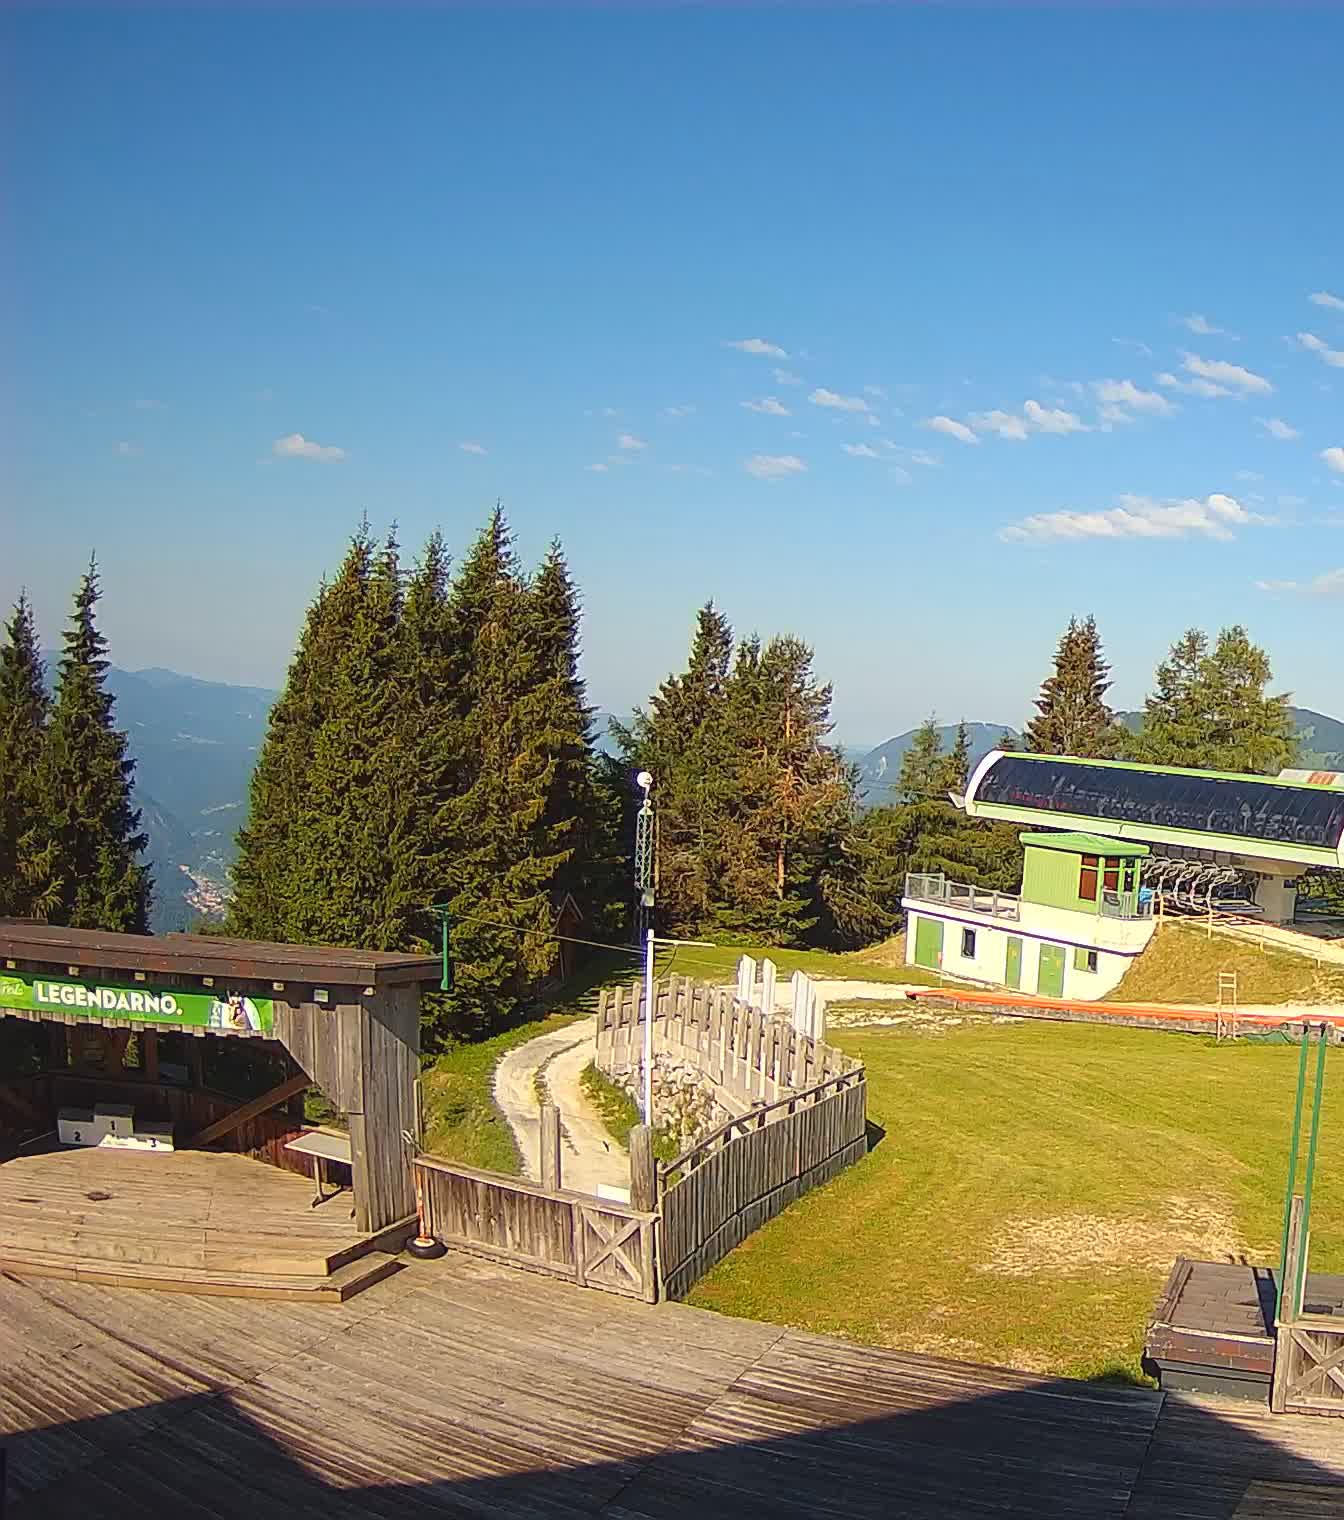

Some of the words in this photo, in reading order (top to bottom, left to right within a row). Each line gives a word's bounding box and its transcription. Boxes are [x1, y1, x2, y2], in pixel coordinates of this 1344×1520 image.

[37, 984, 183, 1016] LEGENDARNO.
[73, 1131, 81, 1142] 2
[150, 1137, 157, 1148] 3
